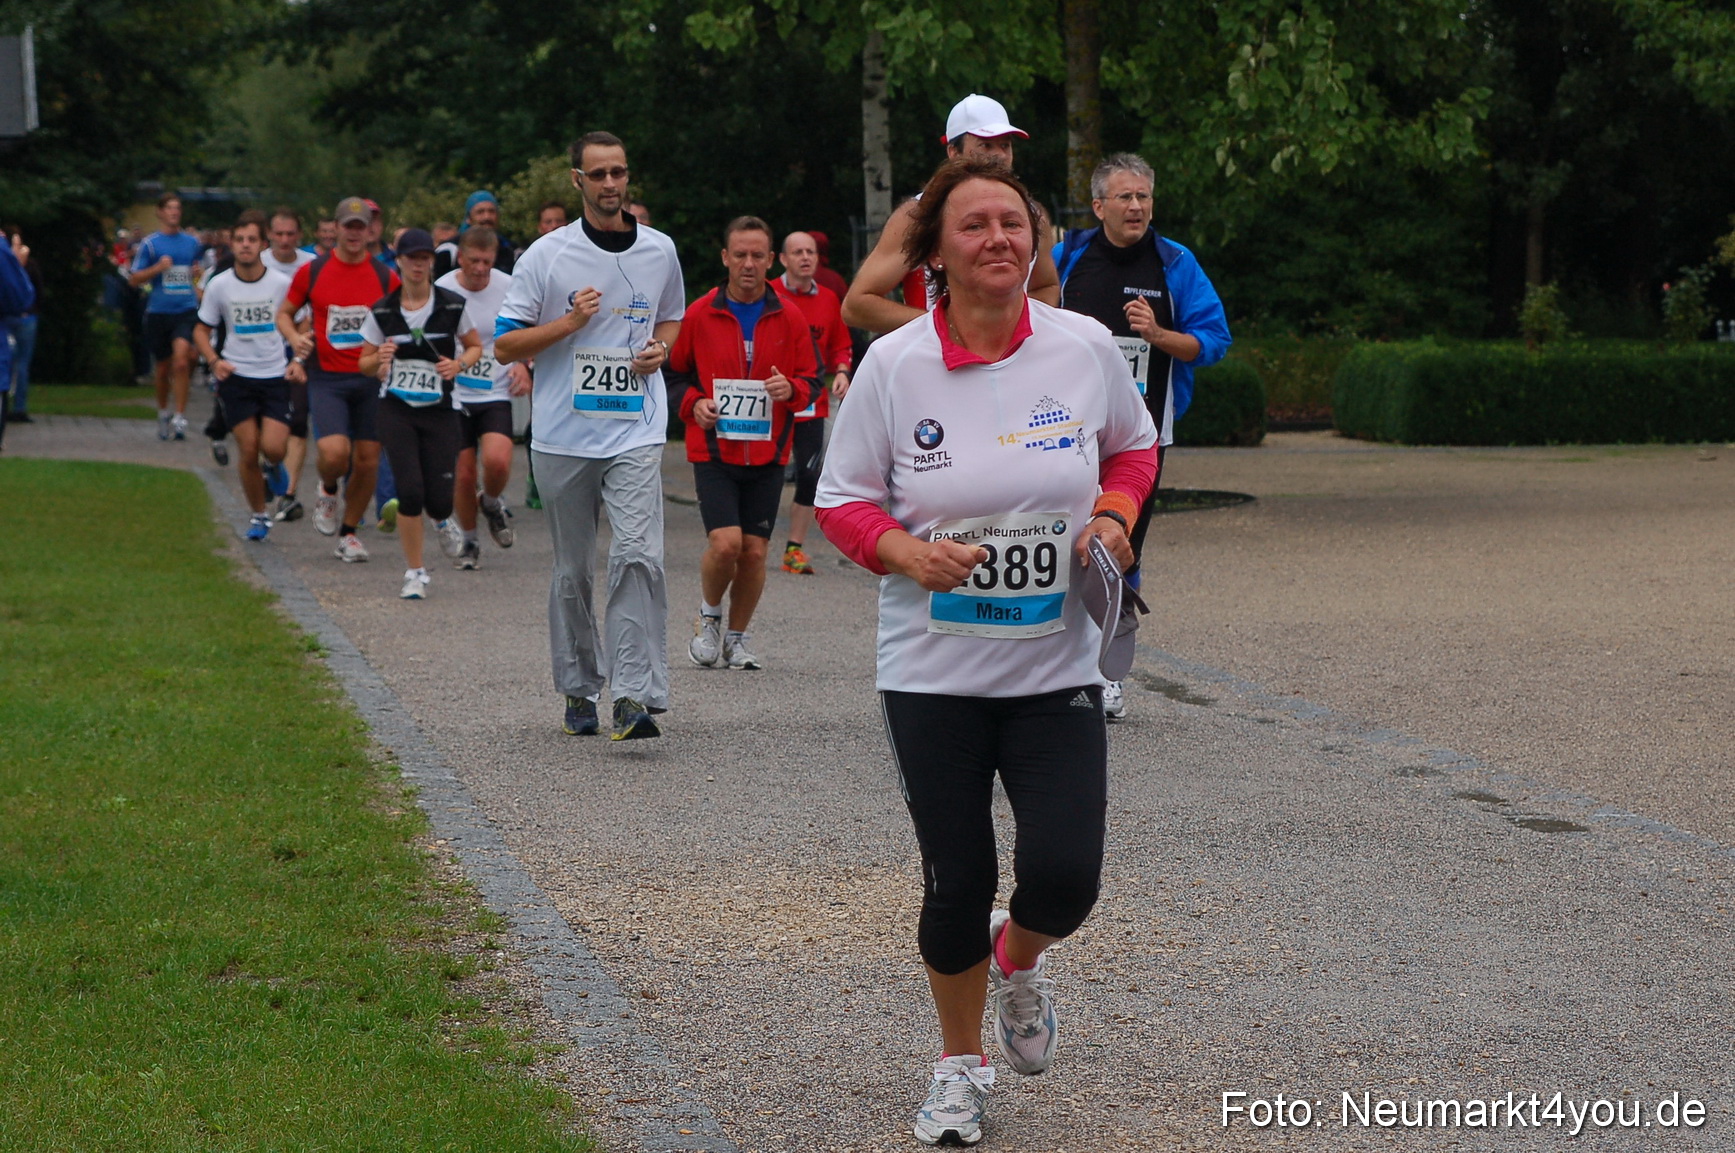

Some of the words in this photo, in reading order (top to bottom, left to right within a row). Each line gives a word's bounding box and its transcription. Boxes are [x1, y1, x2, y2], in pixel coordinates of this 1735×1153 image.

[234, 307, 272, 323] 2495
[575, 353, 601, 361] PARTL
[397, 371, 436, 390] 2744
[596, 398, 628, 410] Sönke
[719, 394, 767, 418] 2771
[727, 422, 759, 432] Michael
[997, 433, 1020, 447] 14.
[913, 451, 952, 465] PARTL
[913, 461, 952, 473] Neumarkt
[983, 525, 1047, 538] Neumarkt
[954, 541, 1058, 591] 389
[976, 602, 1023, 621] Mara
